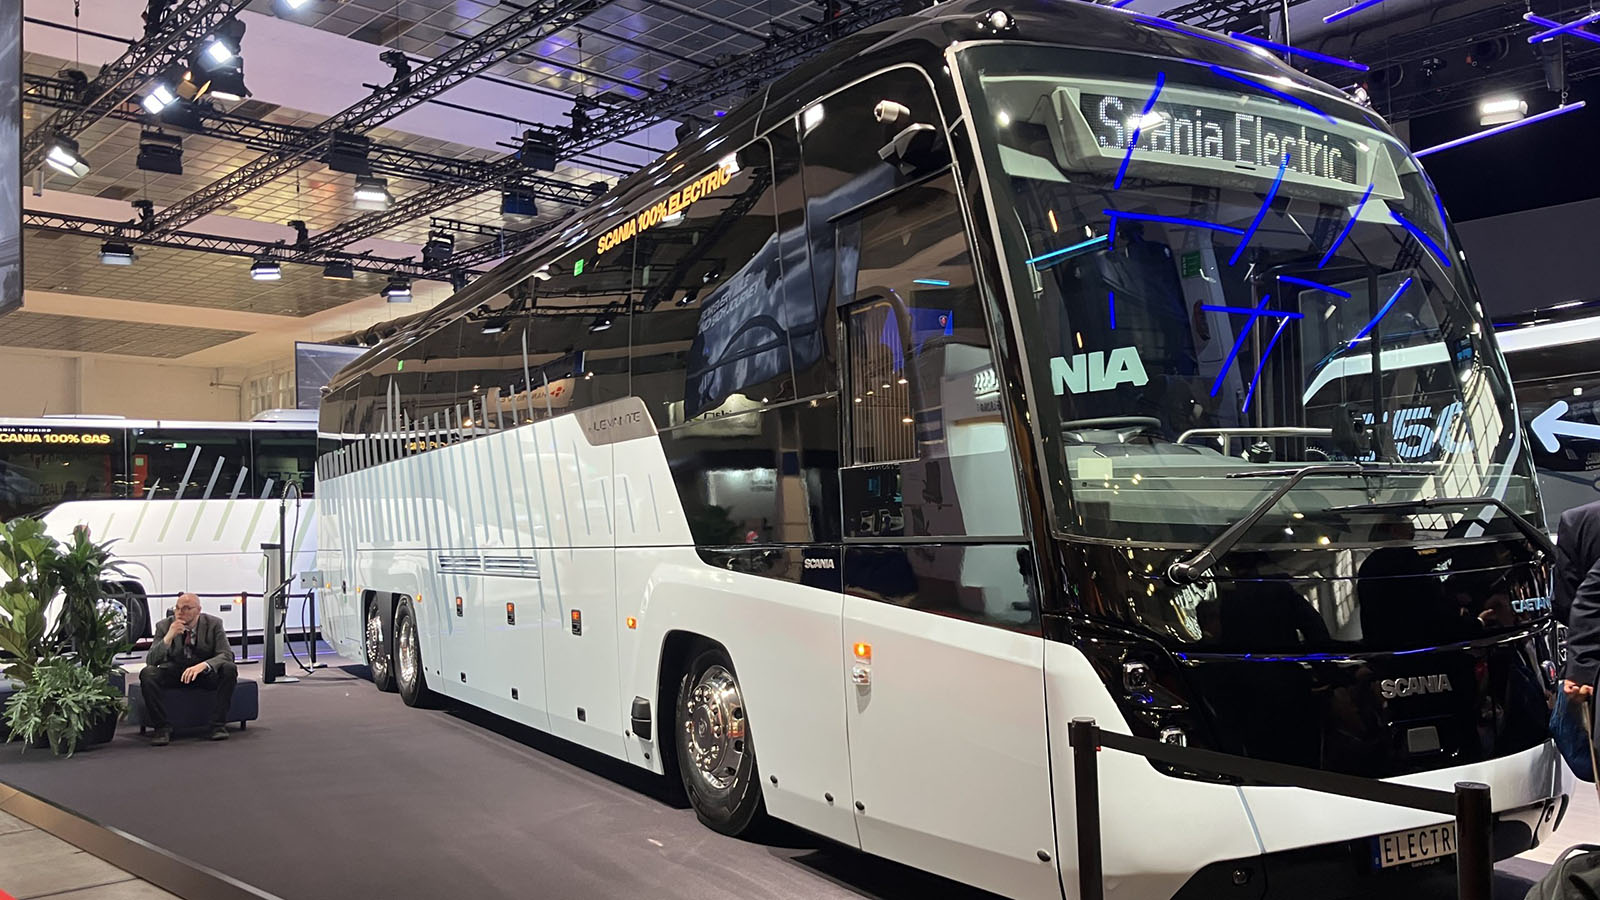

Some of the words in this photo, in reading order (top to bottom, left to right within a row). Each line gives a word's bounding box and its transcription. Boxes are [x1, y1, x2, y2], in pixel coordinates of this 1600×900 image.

[1235, 112, 1343, 181] Electric
[597, 218, 637, 254] SCANIA
[637, 200, 667, 232] 100%
[668, 163, 733, 214] ELECTRIC
[43, 434, 80, 444] 100%
[81, 434, 111, 444] GAS
[804, 558, 835, 569] SCANIA
[1380, 674, 1453, 699] SCANIA
